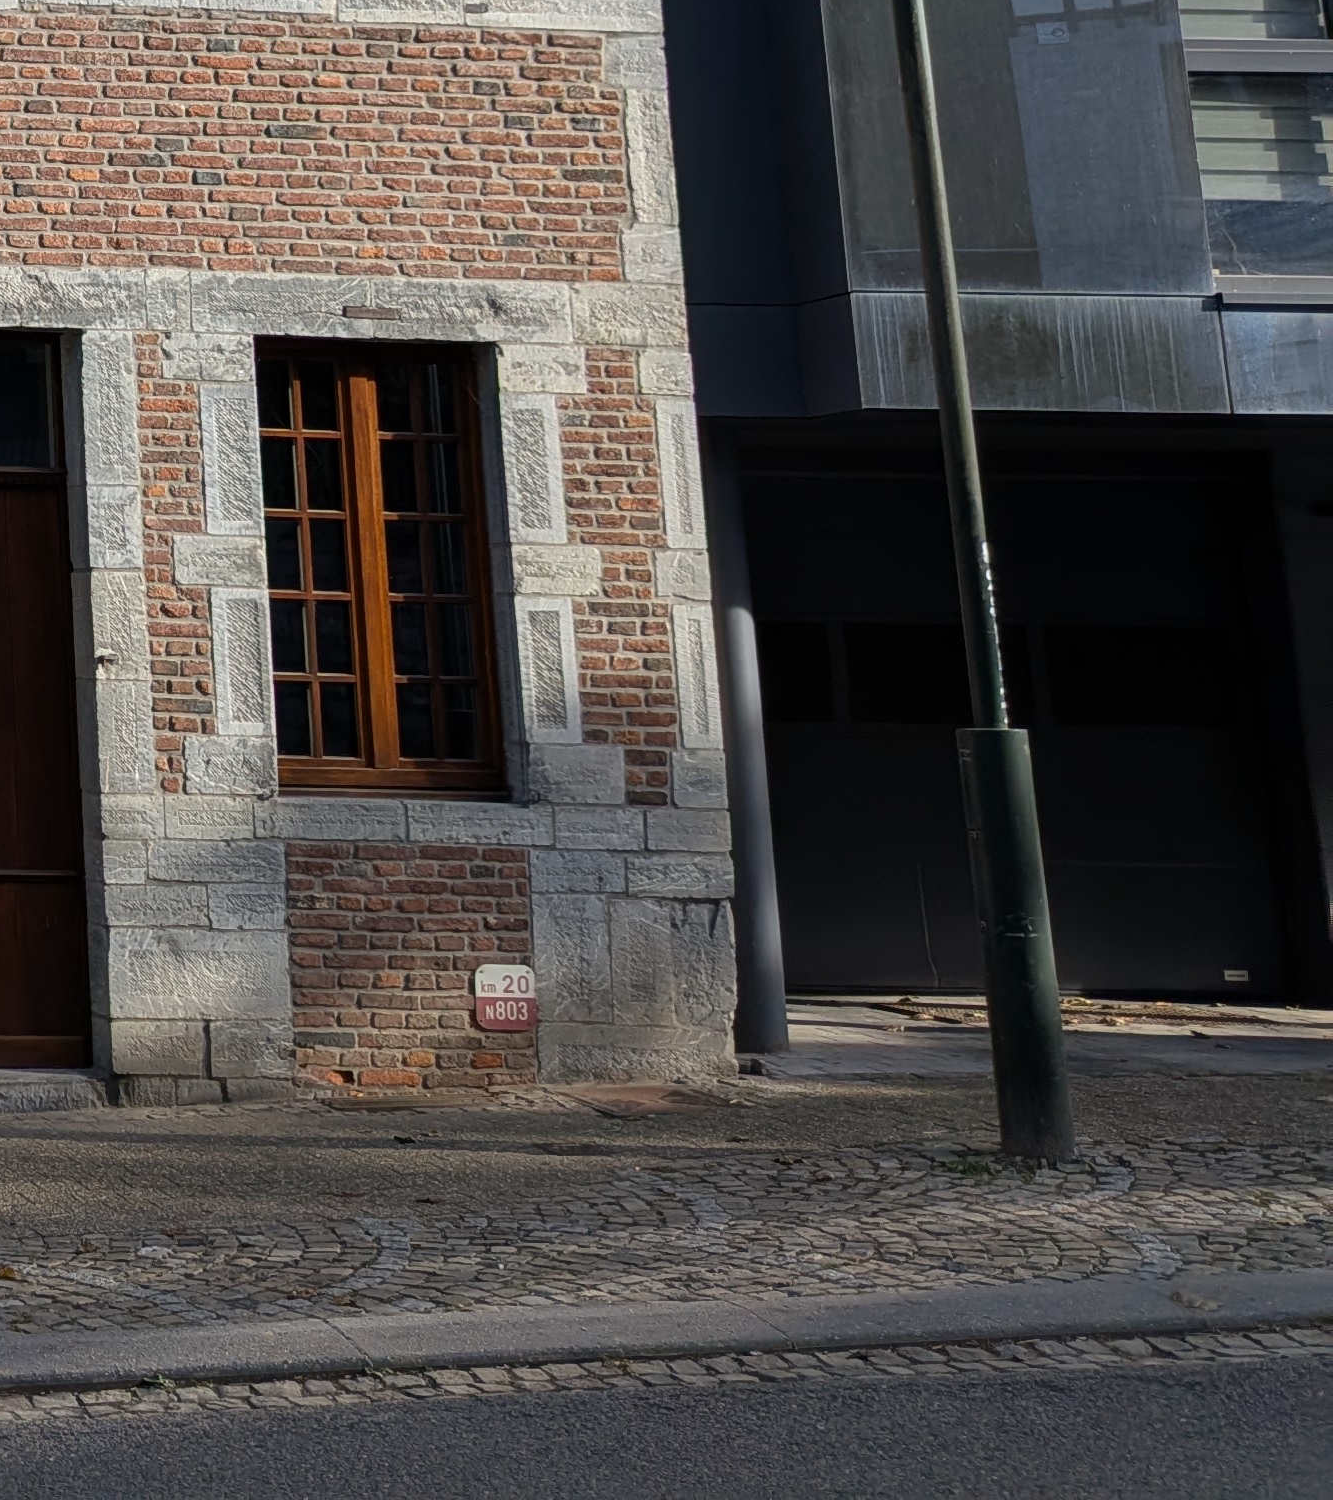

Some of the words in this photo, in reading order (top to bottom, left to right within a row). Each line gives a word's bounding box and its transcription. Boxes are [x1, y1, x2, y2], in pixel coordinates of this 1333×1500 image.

[480, 980, 497, 994] km
[501, 974, 530, 994] 20
[485, 1001, 528, 1021] N803
